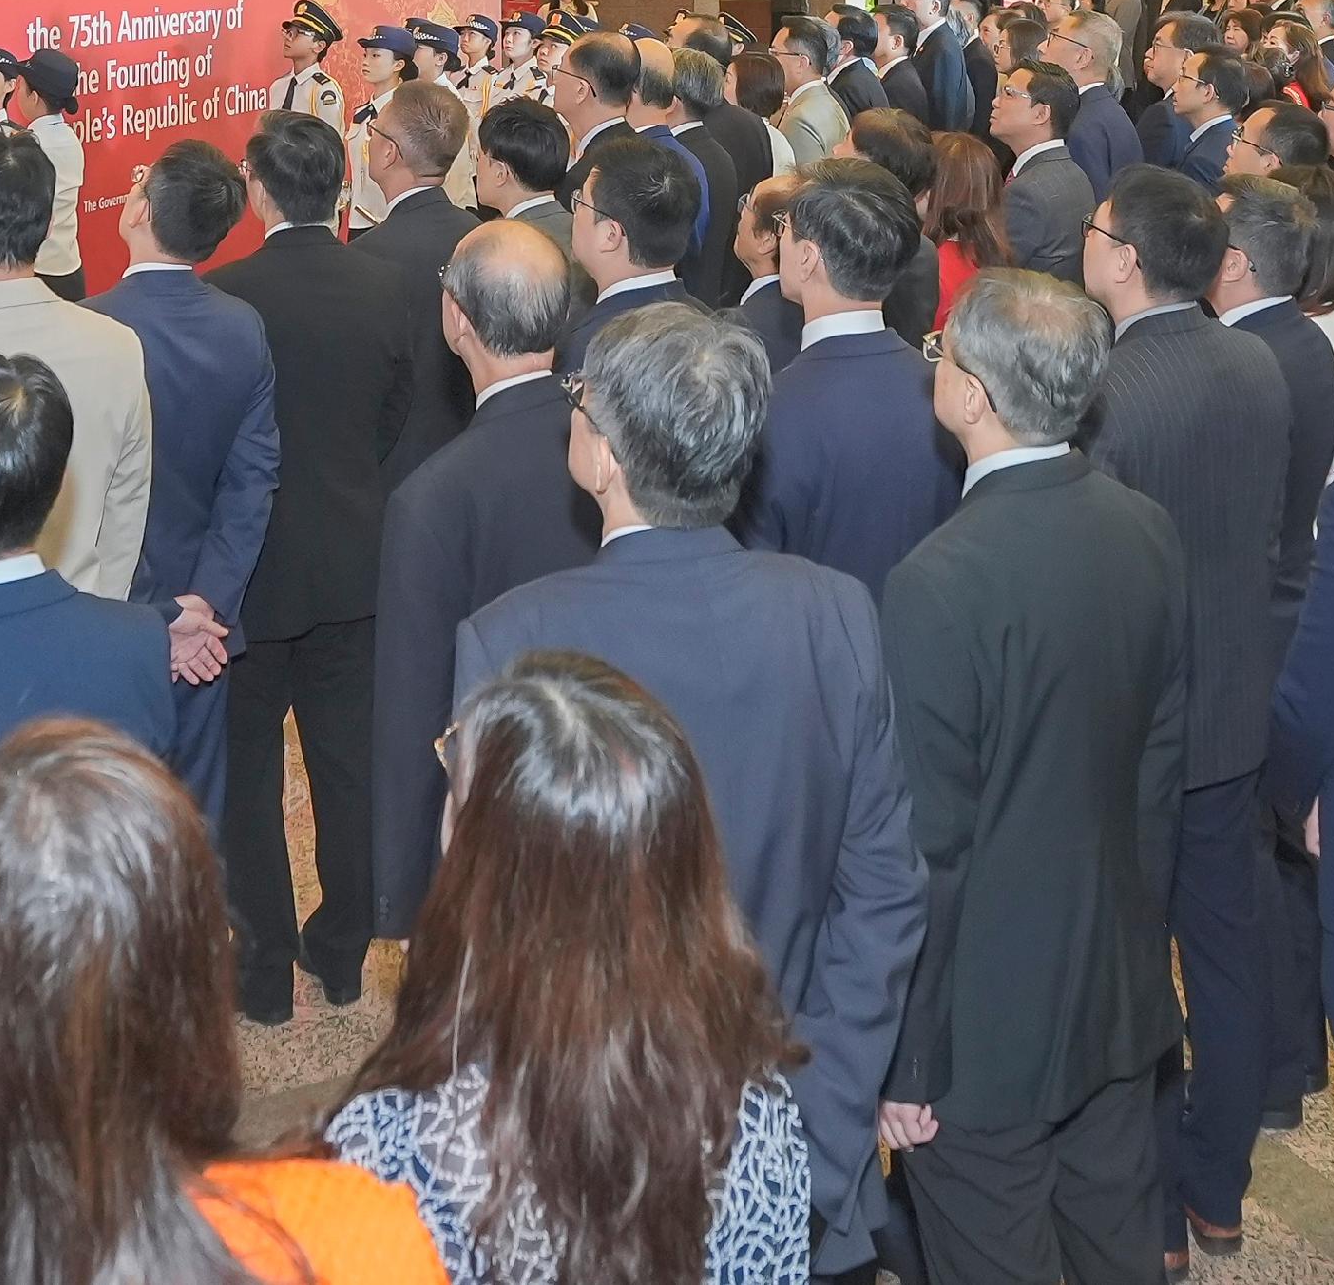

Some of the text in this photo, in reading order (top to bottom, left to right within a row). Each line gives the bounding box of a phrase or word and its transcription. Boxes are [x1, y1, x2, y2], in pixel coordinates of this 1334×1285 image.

[27, 16, 61, 53] the
[68, 11, 112, 49] 75th
[117, 6, 222, 43] Anniversary
[76, 44, 213, 96] he Founding of
[73, 83, 267, 145] ple's Republic of China
[83, 200, 97, 213] The
